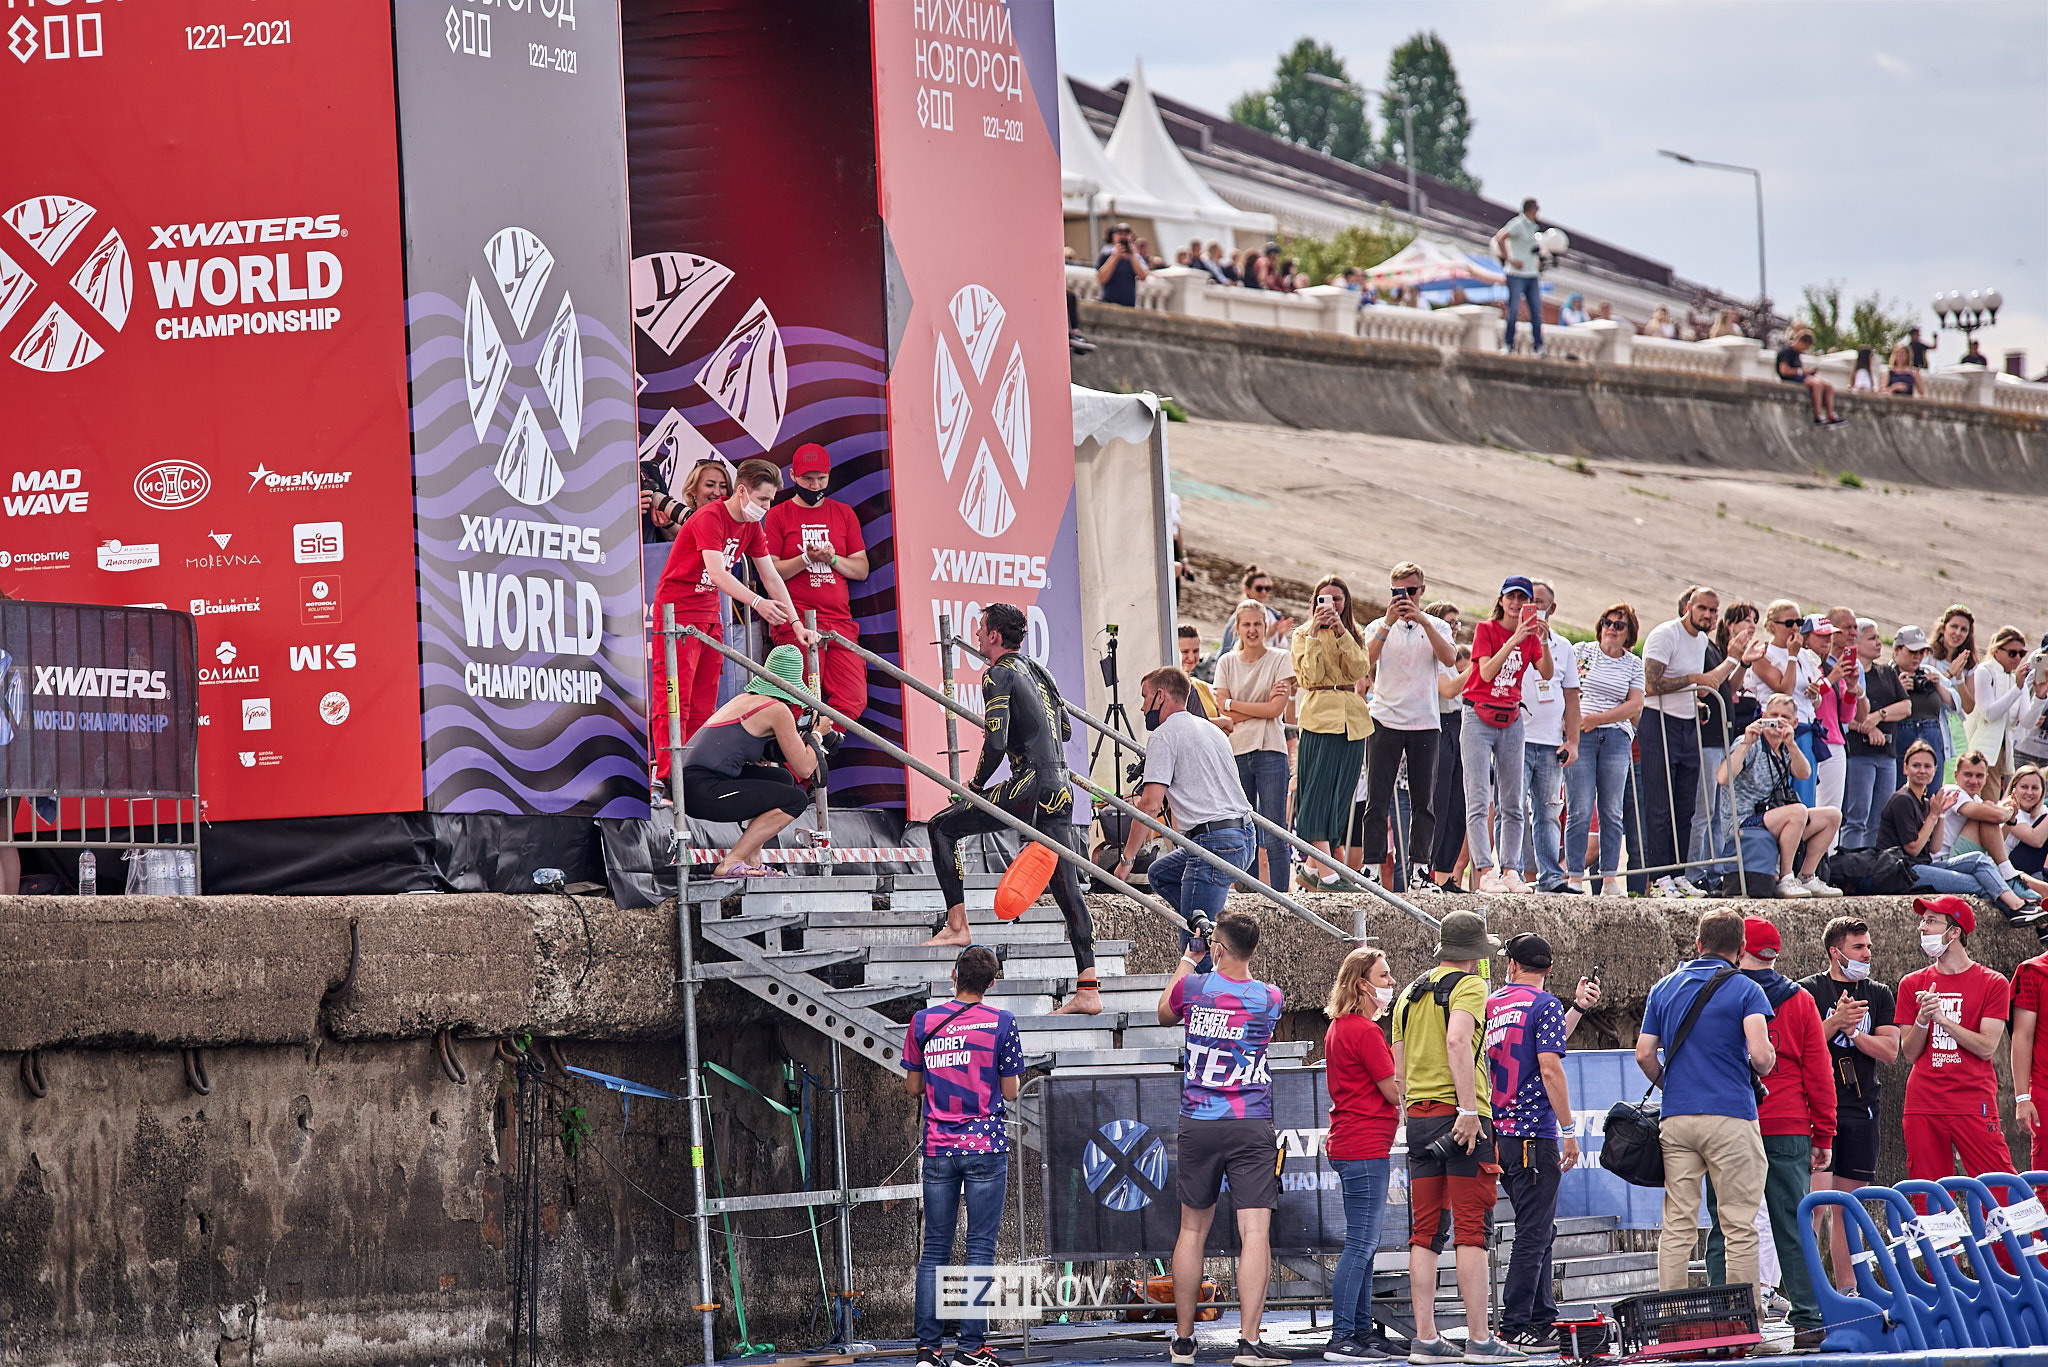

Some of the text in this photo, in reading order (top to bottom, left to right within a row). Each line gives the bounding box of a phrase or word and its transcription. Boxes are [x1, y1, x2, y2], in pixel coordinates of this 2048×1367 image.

[915, 38, 1022, 103] НОВГОРОД
[148, 250, 343, 310] WORLD
[155, 307, 341, 341] CHAMPIONSHIP
[12, 468, 82, 493] MAD
[142, 477, 202, 494] ИСТОК
[264, 470, 353, 491] ФизКульт
[3, 491, 89, 517] WAVE
[802, 529, 830, 541] DON'T
[13, 550, 70, 564] открытие
[105, 557, 153, 567] Диаспорал
[206, 596, 260, 606] ЦЕНТР
[206, 602, 261, 614] СОЦИНТЕХ
[458, 570, 603, 656] WORLD
[931, 599, 1050, 672] WOD
[198, 665, 259, 681] ОЛИМП
[465, 661, 602, 705] CHAMPIONSHIP
[33, 709, 169, 734] WORLD CHAMPIONSHIP
[1938, 997, 1964, 1011] ON'T
[1190, 1011, 1229, 1026] СЕМЕН
[1486, 1010, 1523, 1032] EXANDER
[1188, 1021, 1244, 1040] ВАСИЛЬЕВ
[924, 1035, 967, 1053] ANDREY
